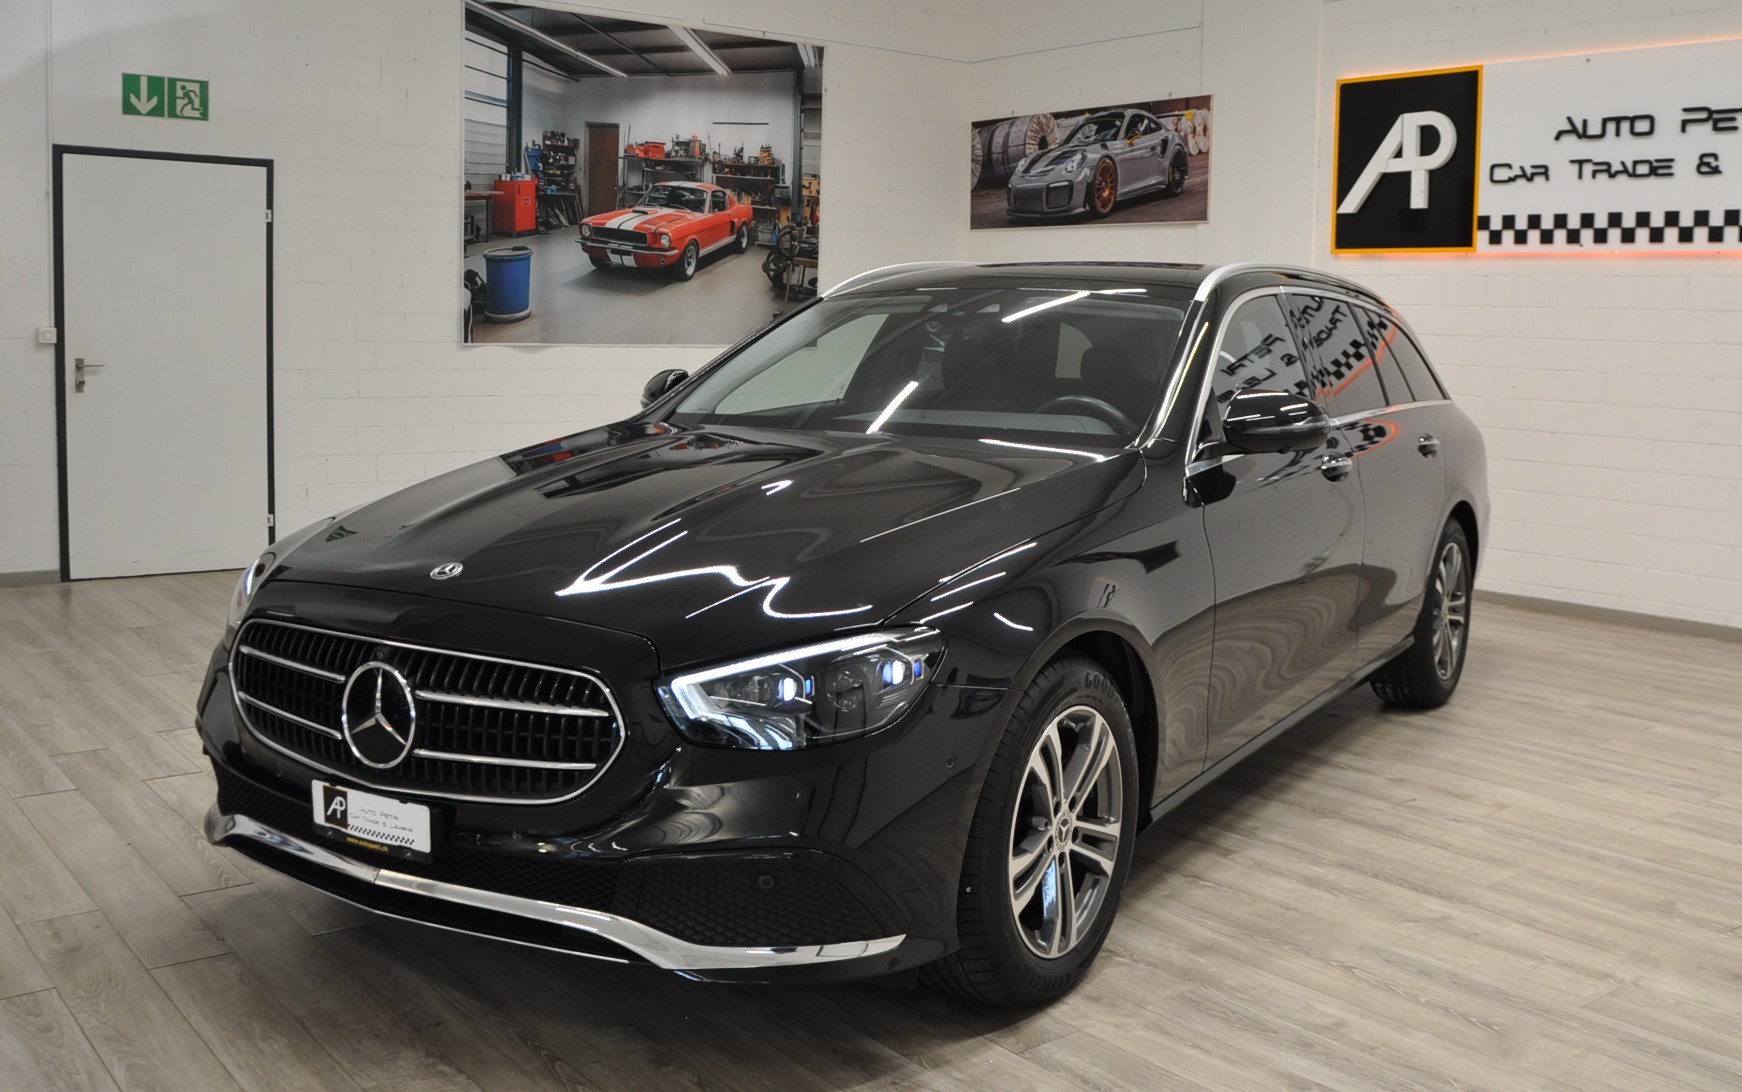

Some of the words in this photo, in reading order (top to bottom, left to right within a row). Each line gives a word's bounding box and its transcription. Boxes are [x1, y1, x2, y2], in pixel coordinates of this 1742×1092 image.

[1554, 114, 1655, 141] AUTO
[1681, 106, 1742, 133] PE
[1336, 110, 1457, 214] AP
[1489, 163, 1550, 183] CAR
[1569, 158, 1675, 180] TRADE
[1696, 152, 1722, 175] &
